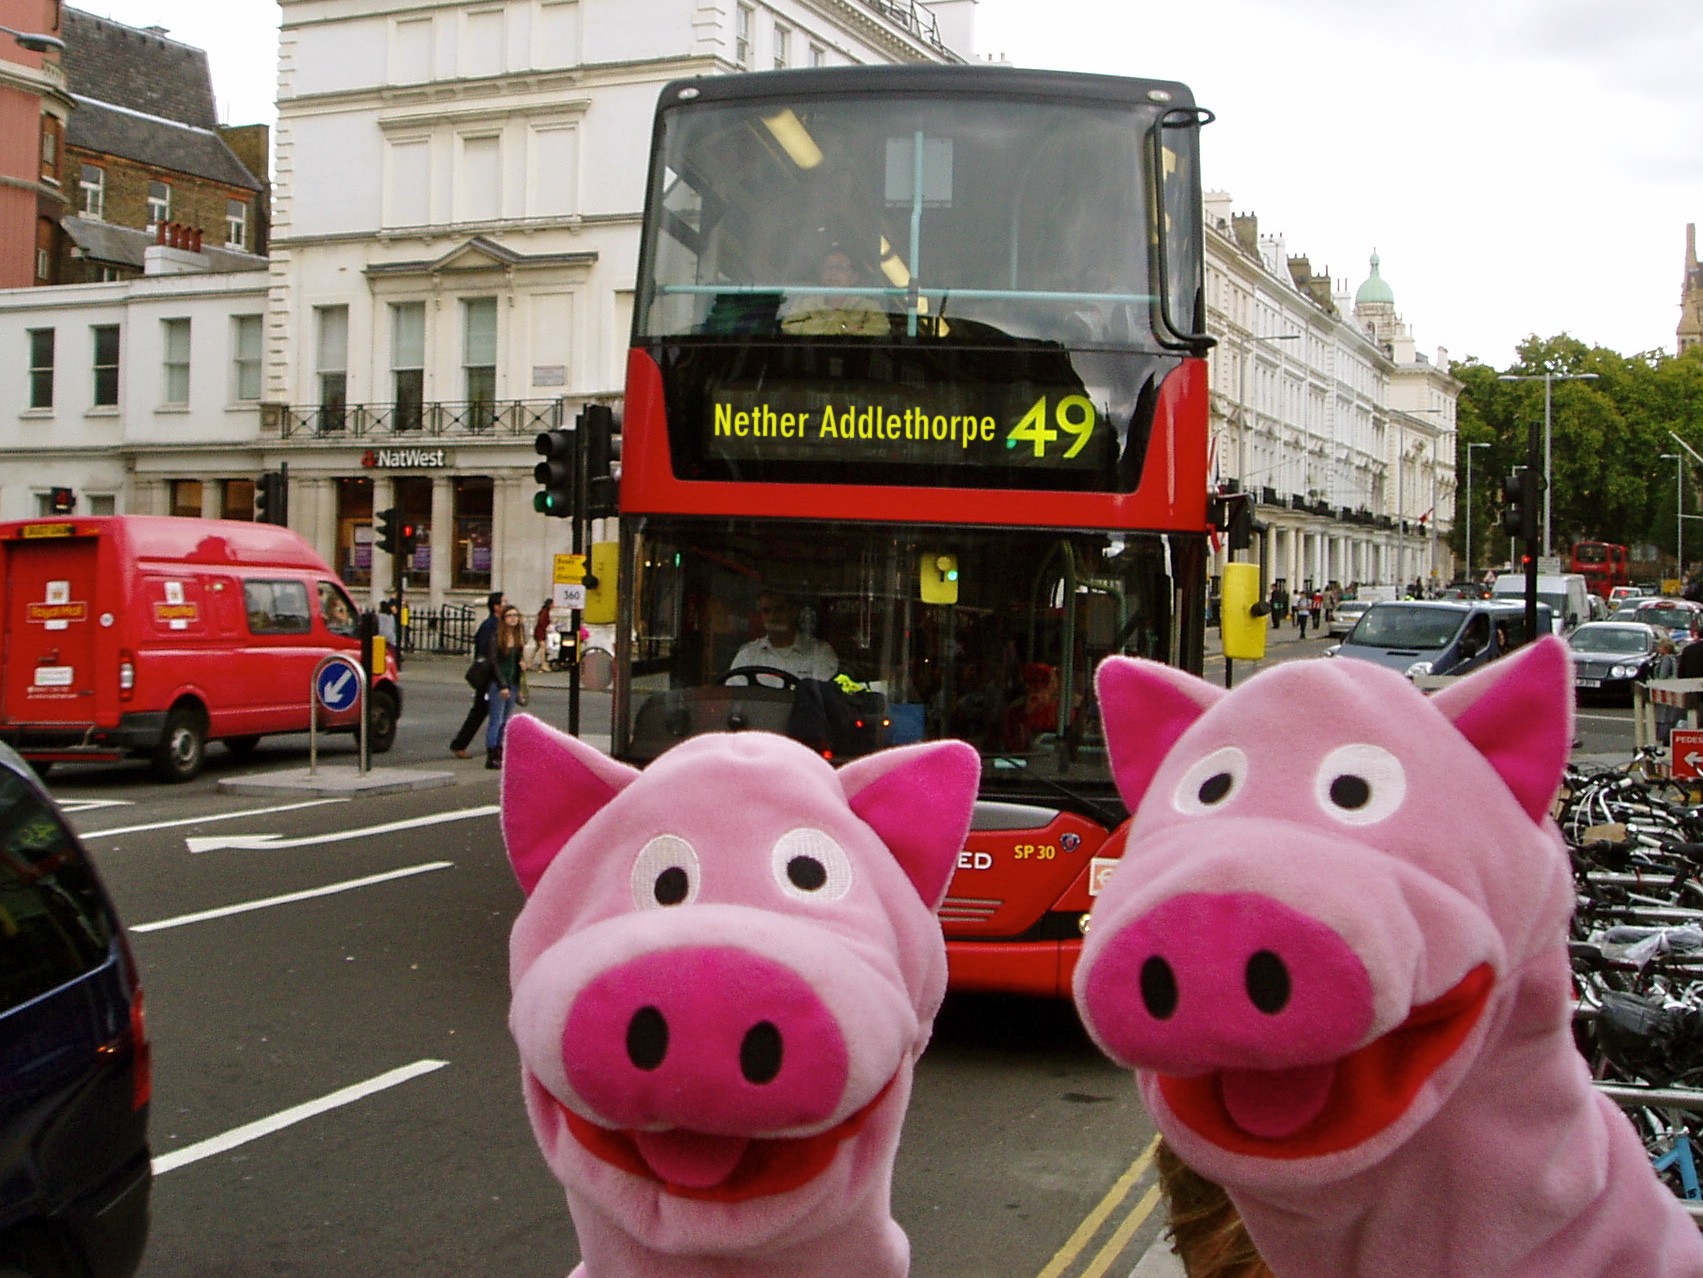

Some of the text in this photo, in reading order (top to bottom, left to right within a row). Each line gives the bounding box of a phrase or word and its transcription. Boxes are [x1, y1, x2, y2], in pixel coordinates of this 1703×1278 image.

[713, 394, 1096, 459] Nether Addlethorpe 49
[377, 448, 444, 467] NatWest
[1014, 844, 1056, 860] SP 30
